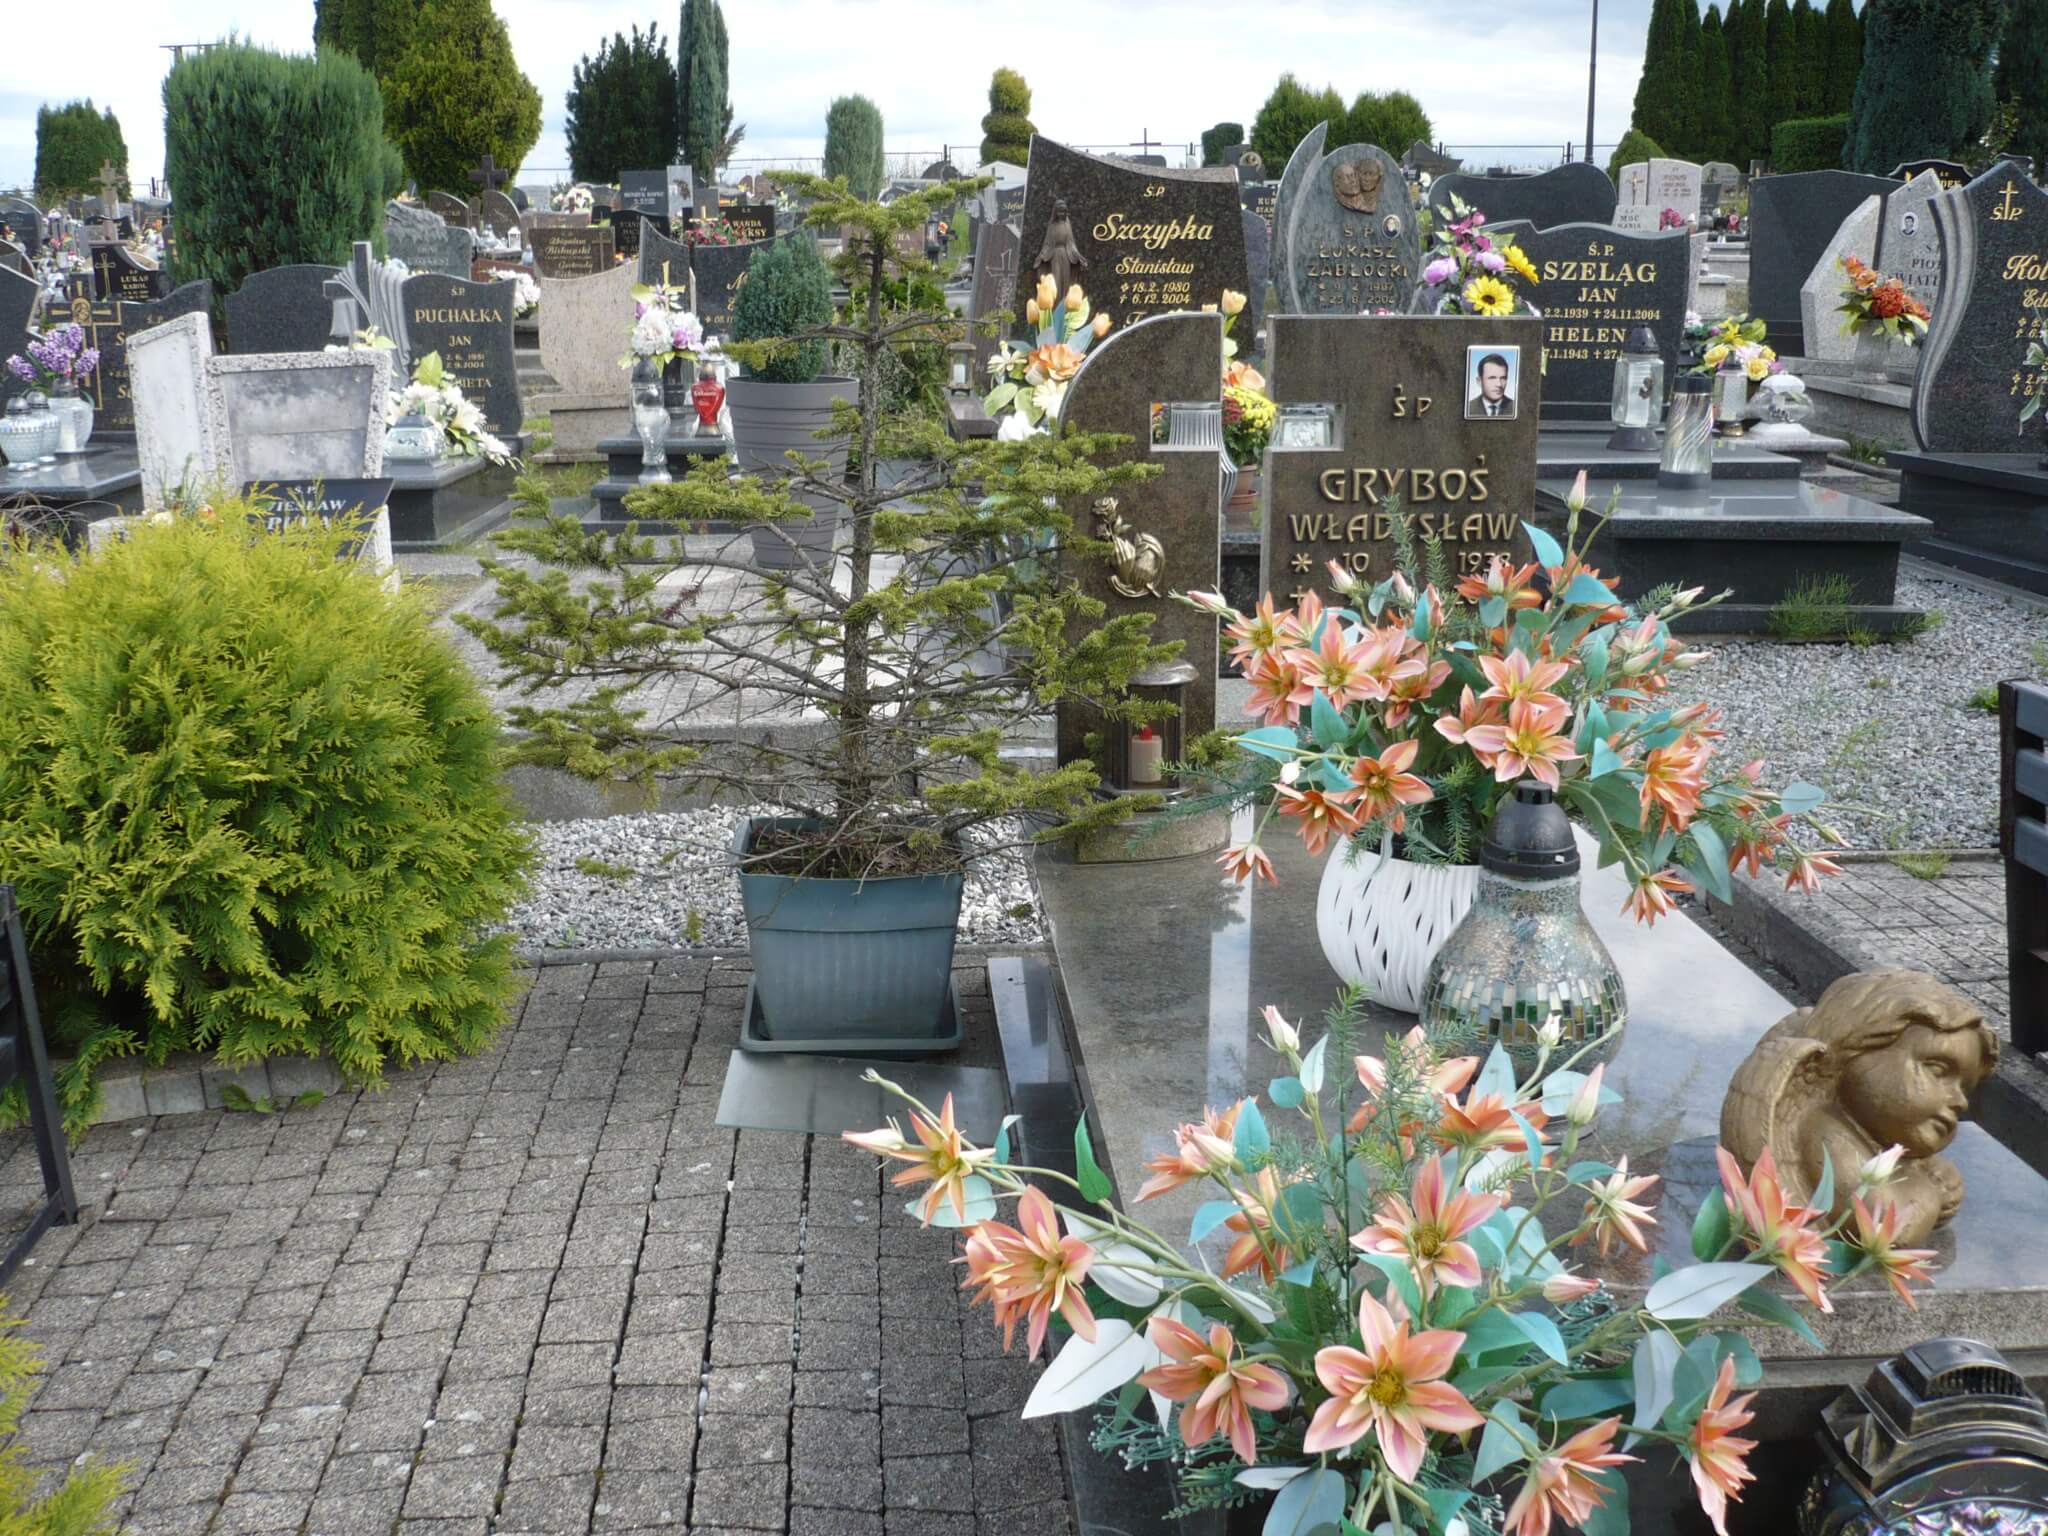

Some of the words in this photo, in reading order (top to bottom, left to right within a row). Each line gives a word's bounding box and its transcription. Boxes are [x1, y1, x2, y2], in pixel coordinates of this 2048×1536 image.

[1093, 213, 1214, 250] Szczypka
[1115, 256, 1195, 275] Stanisław
[1543, 260, 1657, 287] SZELĄG
[1577, 287, 1617, 303] JAN
[414, 308, 503, 324] PUCHAŁKA
[448, 335, 472, 347] JAN
[1319, 454, 1489, 504] GRYBOŚ
[265, 499, 347, 513] IEŁAW
